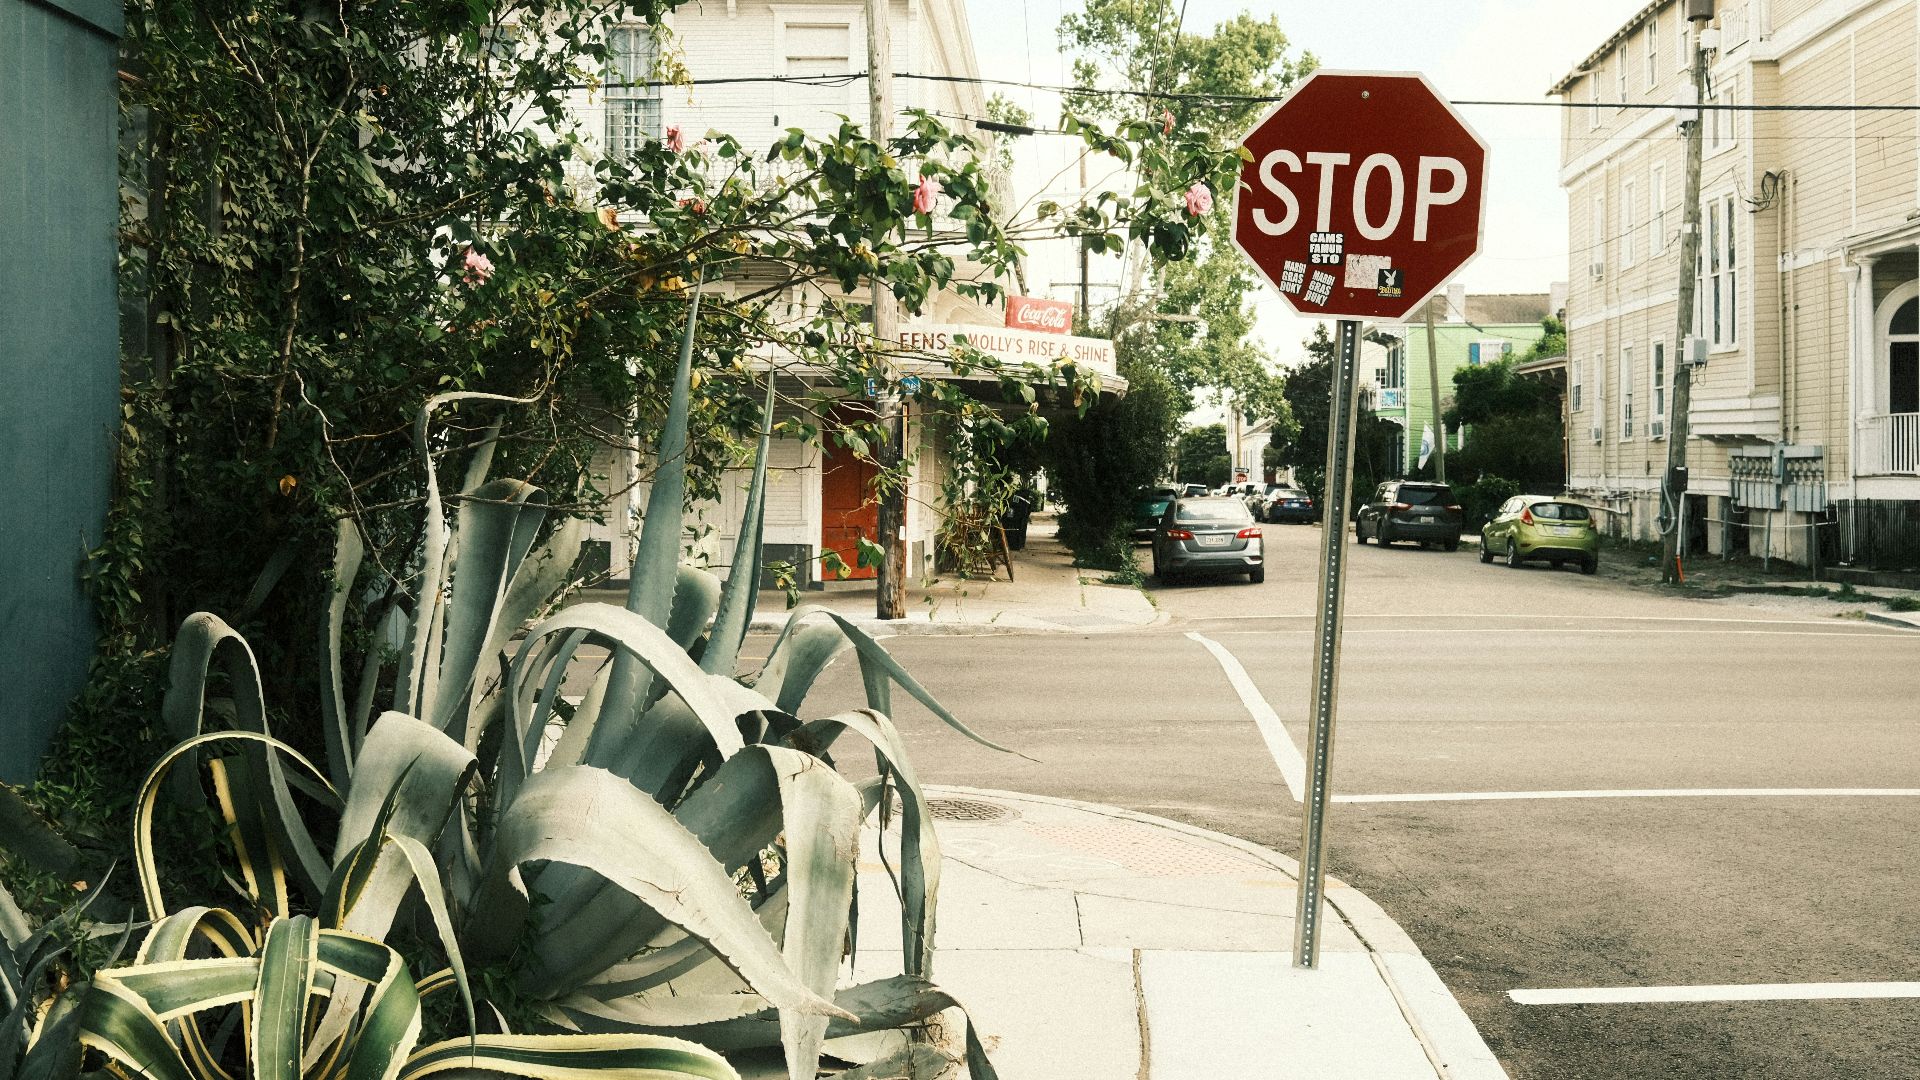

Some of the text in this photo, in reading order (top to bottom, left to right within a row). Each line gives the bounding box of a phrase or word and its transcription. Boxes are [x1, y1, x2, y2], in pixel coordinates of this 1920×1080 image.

[1252, 149, 1468, 242] STOP
[1312, 254, 1339, 263] STO
[1284, 260, 1306, 274] MARDI
[1282, 271, 1303, 284] GRAS
[1312, 269, 1335, 287] MARDI
[1308, 280, 1331, 296] GRAS
[967, 333, 1109, 363] MOLLY'S RISE & SHINE
